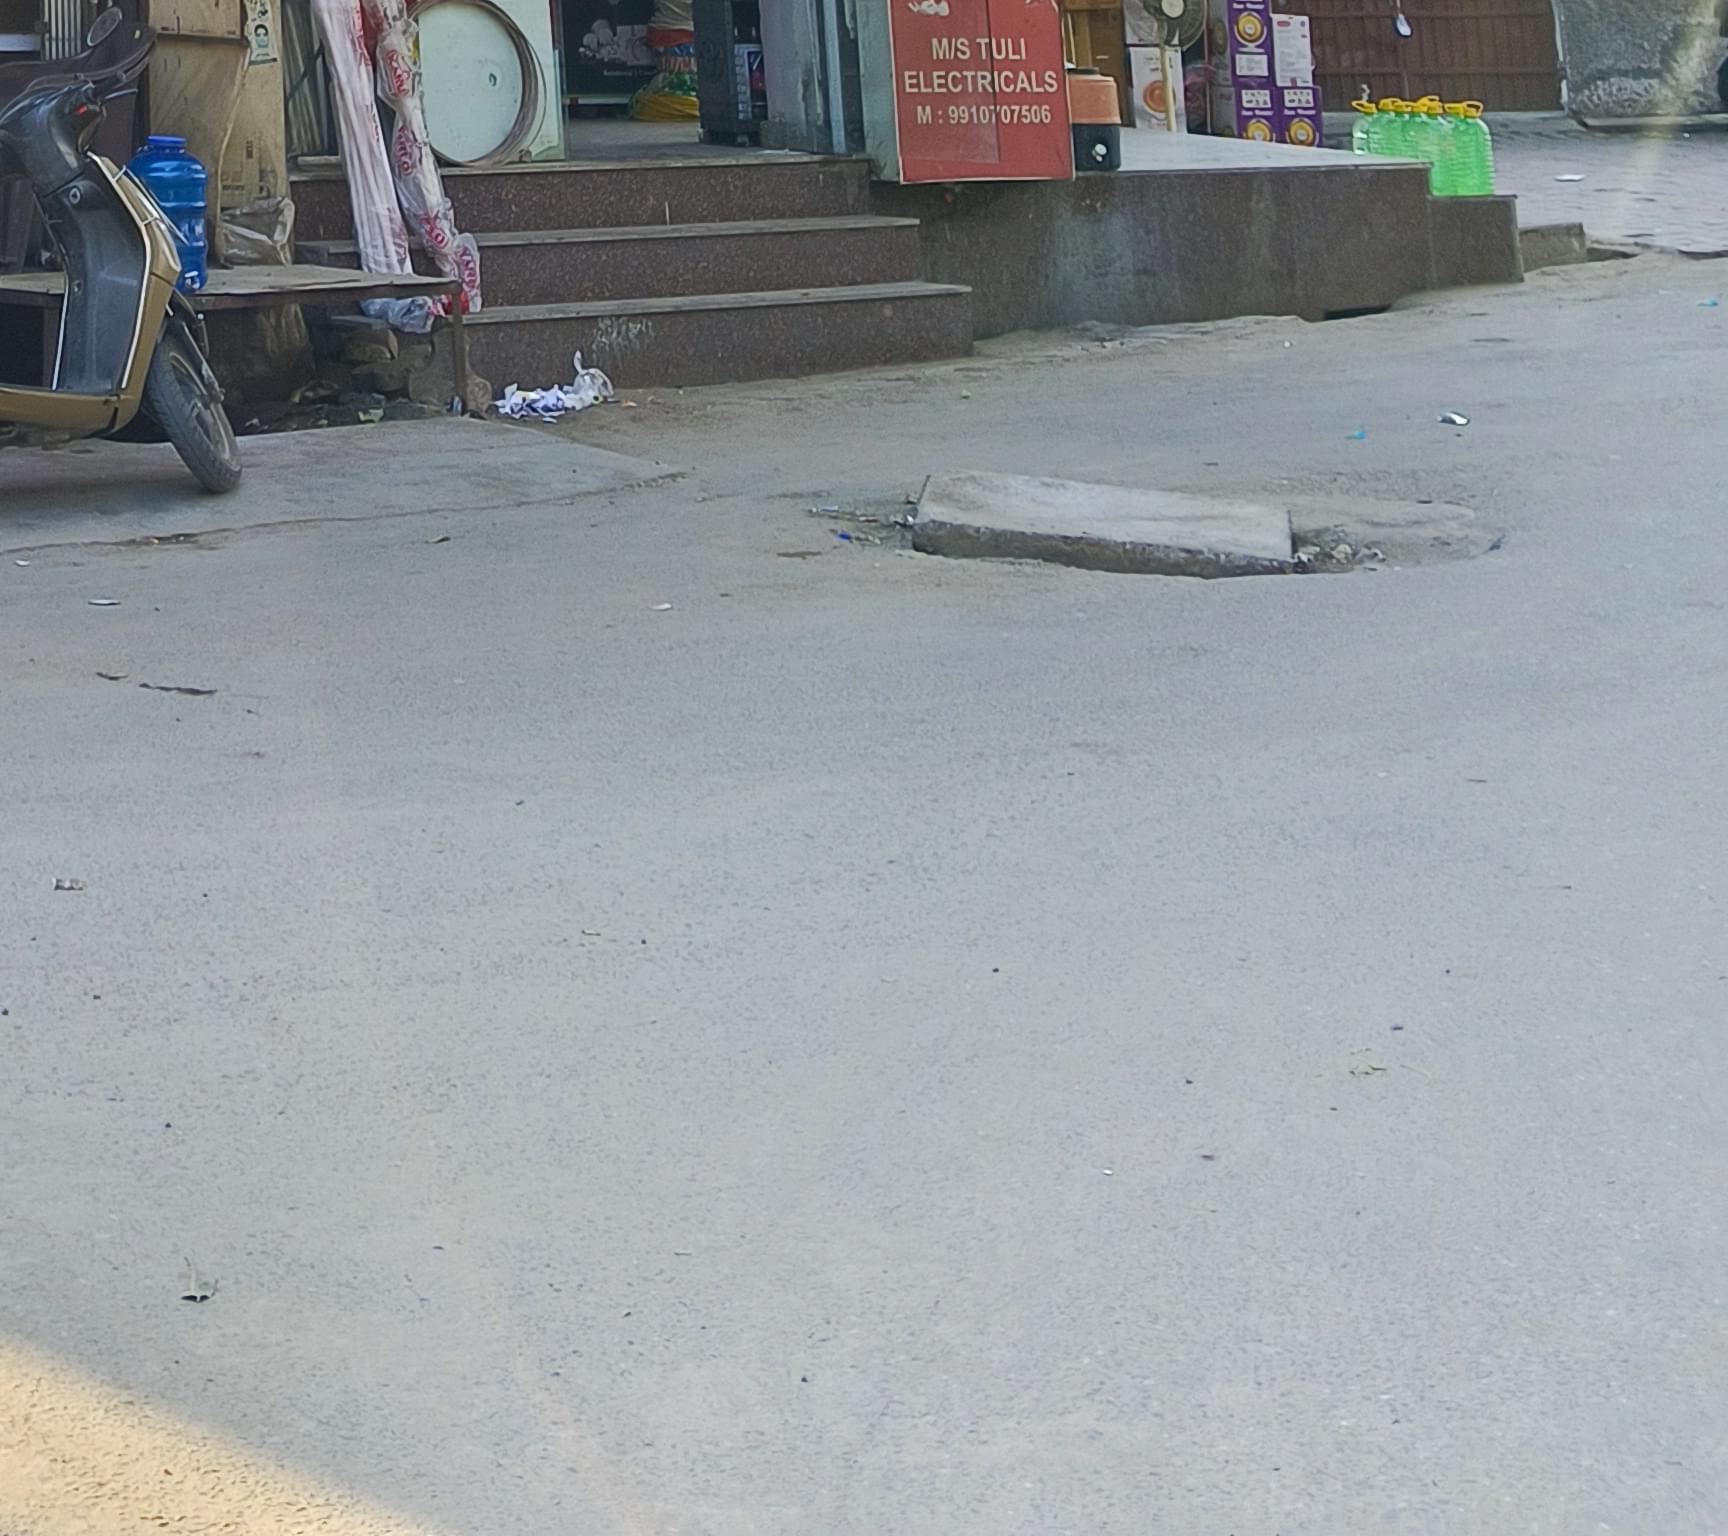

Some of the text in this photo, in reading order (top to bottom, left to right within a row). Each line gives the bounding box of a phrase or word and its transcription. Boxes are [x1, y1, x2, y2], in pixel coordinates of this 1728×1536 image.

[931, 37, 1026, 60] M/S TULI
[904, 70, 1058, 93] ELECTRICALS
[917, 105, 932, 125] M
[948, 105, 1052, 125] 9910707506
